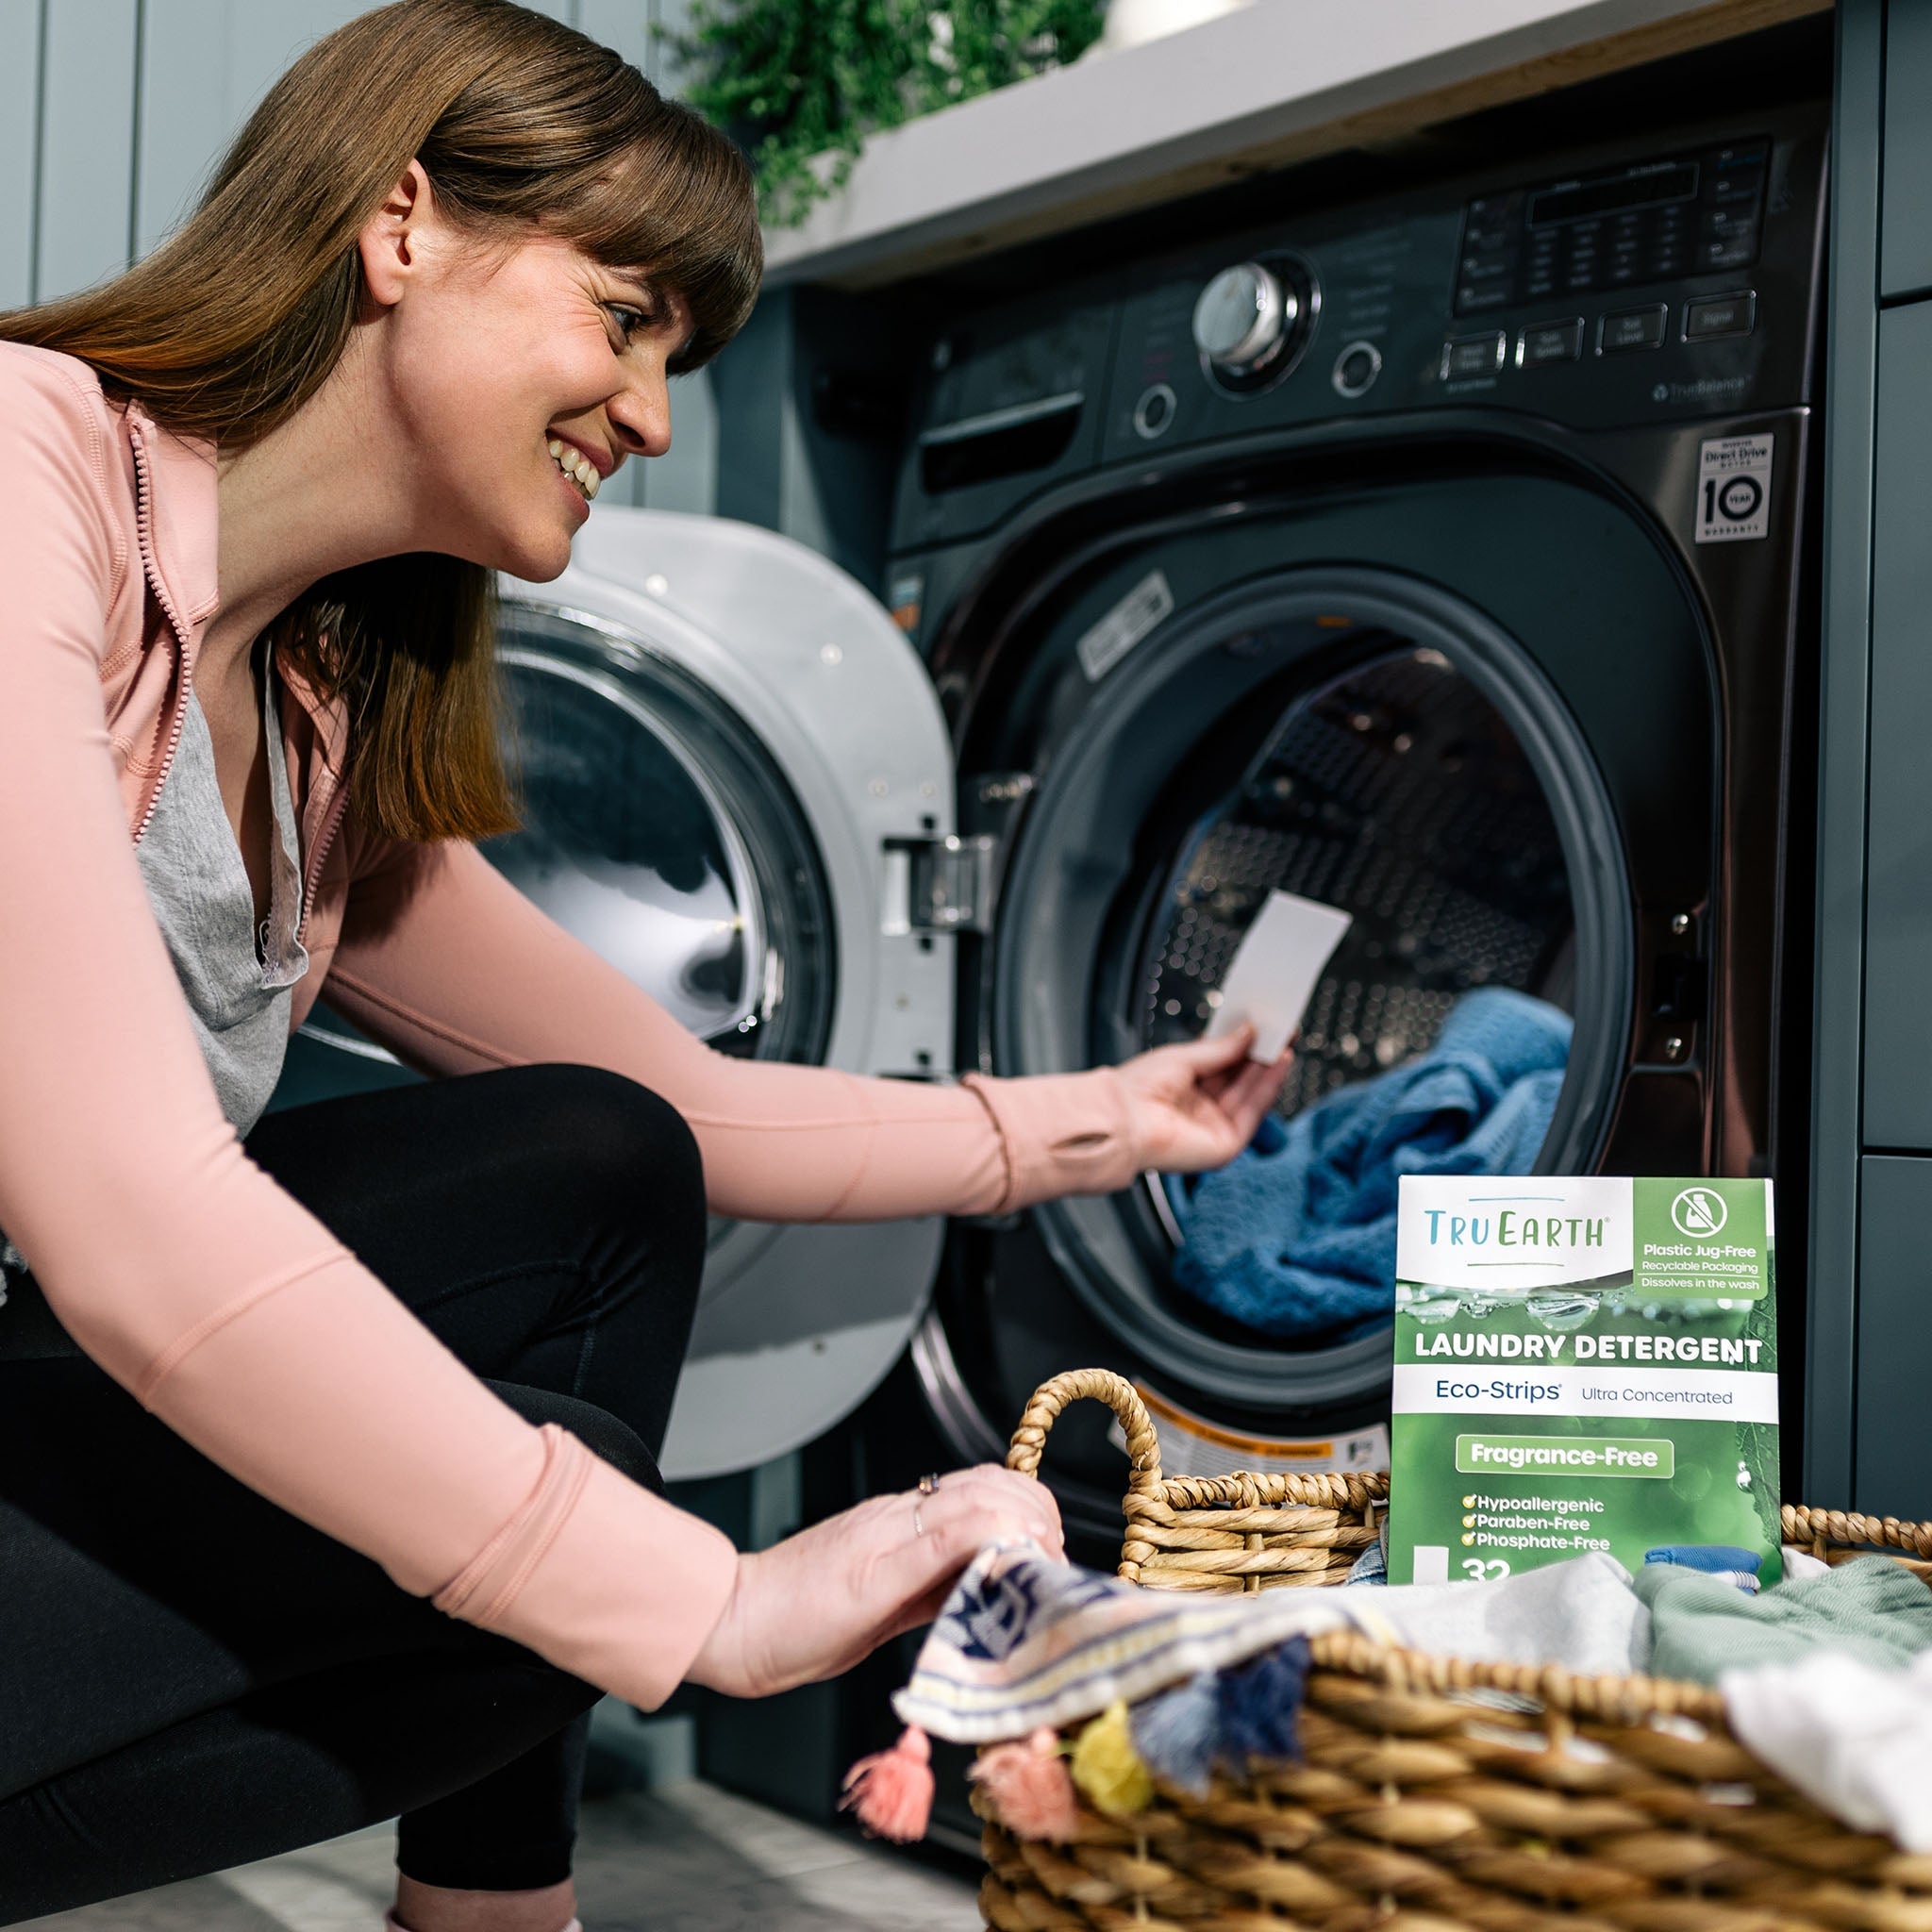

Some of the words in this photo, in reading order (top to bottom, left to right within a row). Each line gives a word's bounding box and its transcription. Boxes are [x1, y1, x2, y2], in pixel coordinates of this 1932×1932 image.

[1706, 450, 1736, 462] Direct
[1739, 447, 1768, 460] Drive
[1705, 475, 1763, 525] 10
[1729, 493, 1752, 504] YEAR
[1643, 1244, 1692, 1257] Plastic
[1695, 1244, 1757, 1259] Jug-Free
[1641, 1261, 1700, 1272] Recyclable
[1702, 1262, 1758, 1274] Packaging
[1641, 1277, 1693, 1288] Dissolves
[1695, 1278, 1706, 1288] in
[1707, 1279, 1726, 1289] the
[1728, 1280, 1760, 1291] wash
[1415, 1332, 1566, 1358] LAUNDRY
[1574, 1335, 1763, 1365] DETERGENT
[1436, 1380, 1560, 1404] Eco-Strips
[1582, 1388, 1618, 1401] Ultra
[1623, 1389, 1733, 1405] Concentrated
[1471, 1443, 1658, 1468] Fragrance-Free
[1477, 1495, 1605, 1514] Hypoallergenic
[1477, 1513, 1591, 1531] Paraben-Free
[1476, 1532, 1610, 1551] Phosphate-Free
